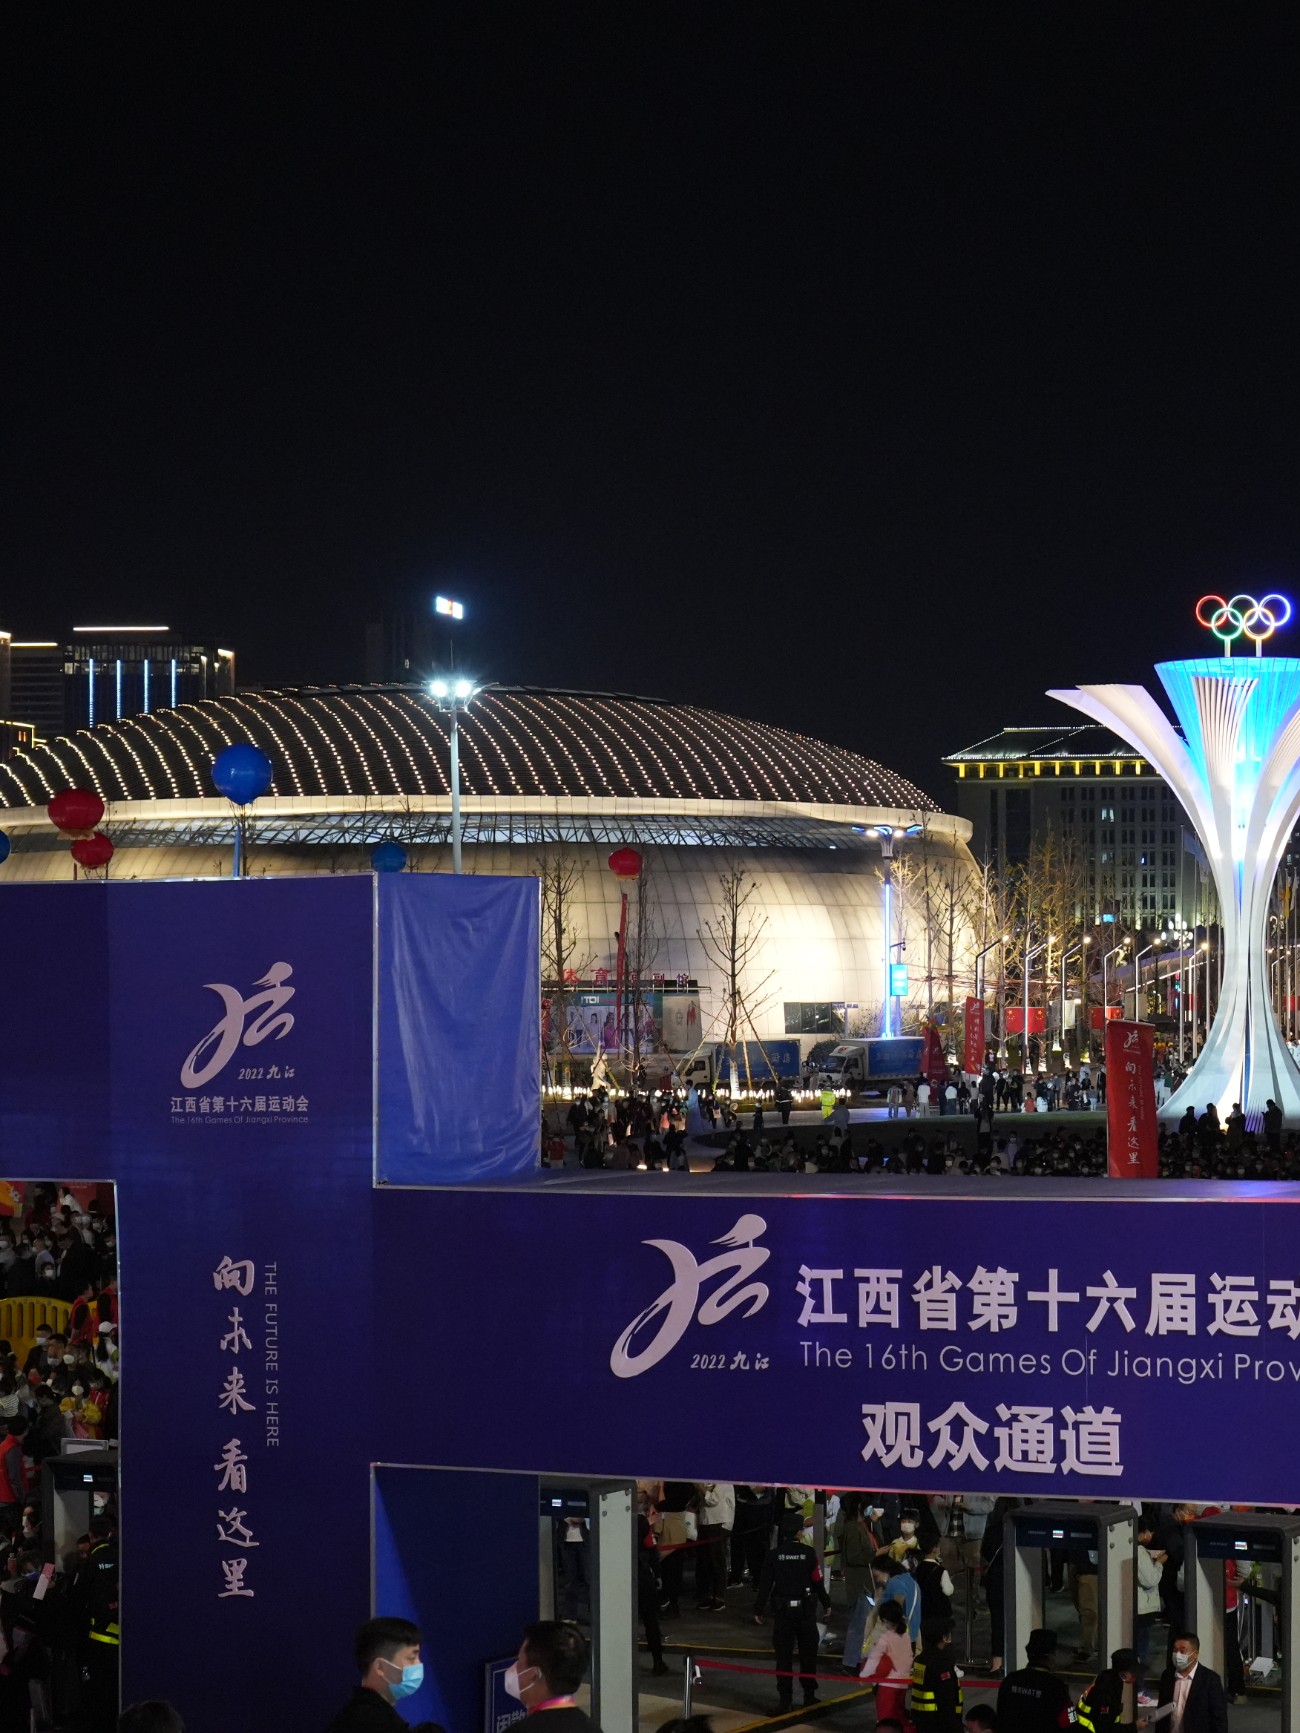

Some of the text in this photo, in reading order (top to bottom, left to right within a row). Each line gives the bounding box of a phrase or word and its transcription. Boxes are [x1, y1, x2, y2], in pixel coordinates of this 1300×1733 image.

[238, 1064, 296, 1080] 2022 九江
[170, 1095, 309, 1113] 江西省第十六届运动会
[171, 1116, 185, 1124] The
[205, 1116, 232, 1124] Games
[246, 1116, 272, 1125] Jiangxi
[274, 1116, 309, 1124] Province
[264, 1262, 279, 1447] THE FUTURE IS HERE
[690, 1351, 770, 1370] 2022 九江
[800, 1341, 852, 1368] The
[865, 1343, 928, 1370] 16th
[939, 1345, 1051, 1375] Games
[1061, 1348, 1099, 1377] Of
[1106, 1350, 1224, 1386] Jiangxi
[212, 1256, 259, 1598] 向未来看这里
[861, 1401, 1124, 1477] 观众通道
